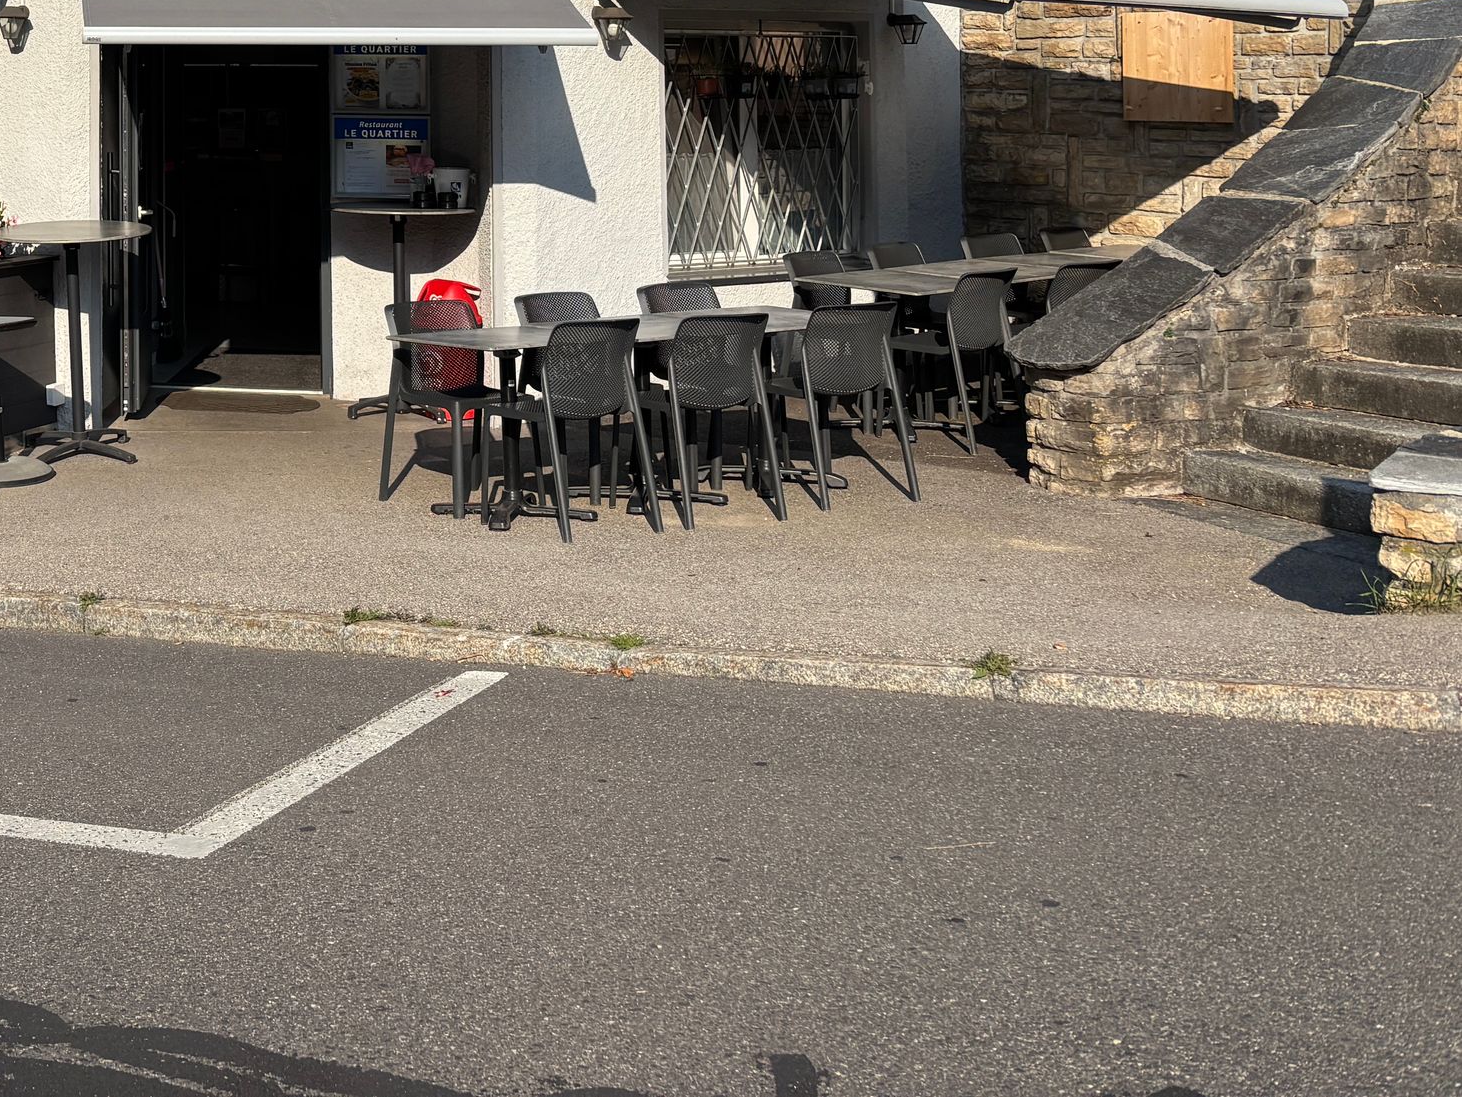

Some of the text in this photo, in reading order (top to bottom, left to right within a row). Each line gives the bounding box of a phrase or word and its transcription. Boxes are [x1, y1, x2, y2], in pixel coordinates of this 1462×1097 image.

[344, 45, 417, 53] LE QUARTIER
[344, 129, 418, 138] LE QUARTIER
